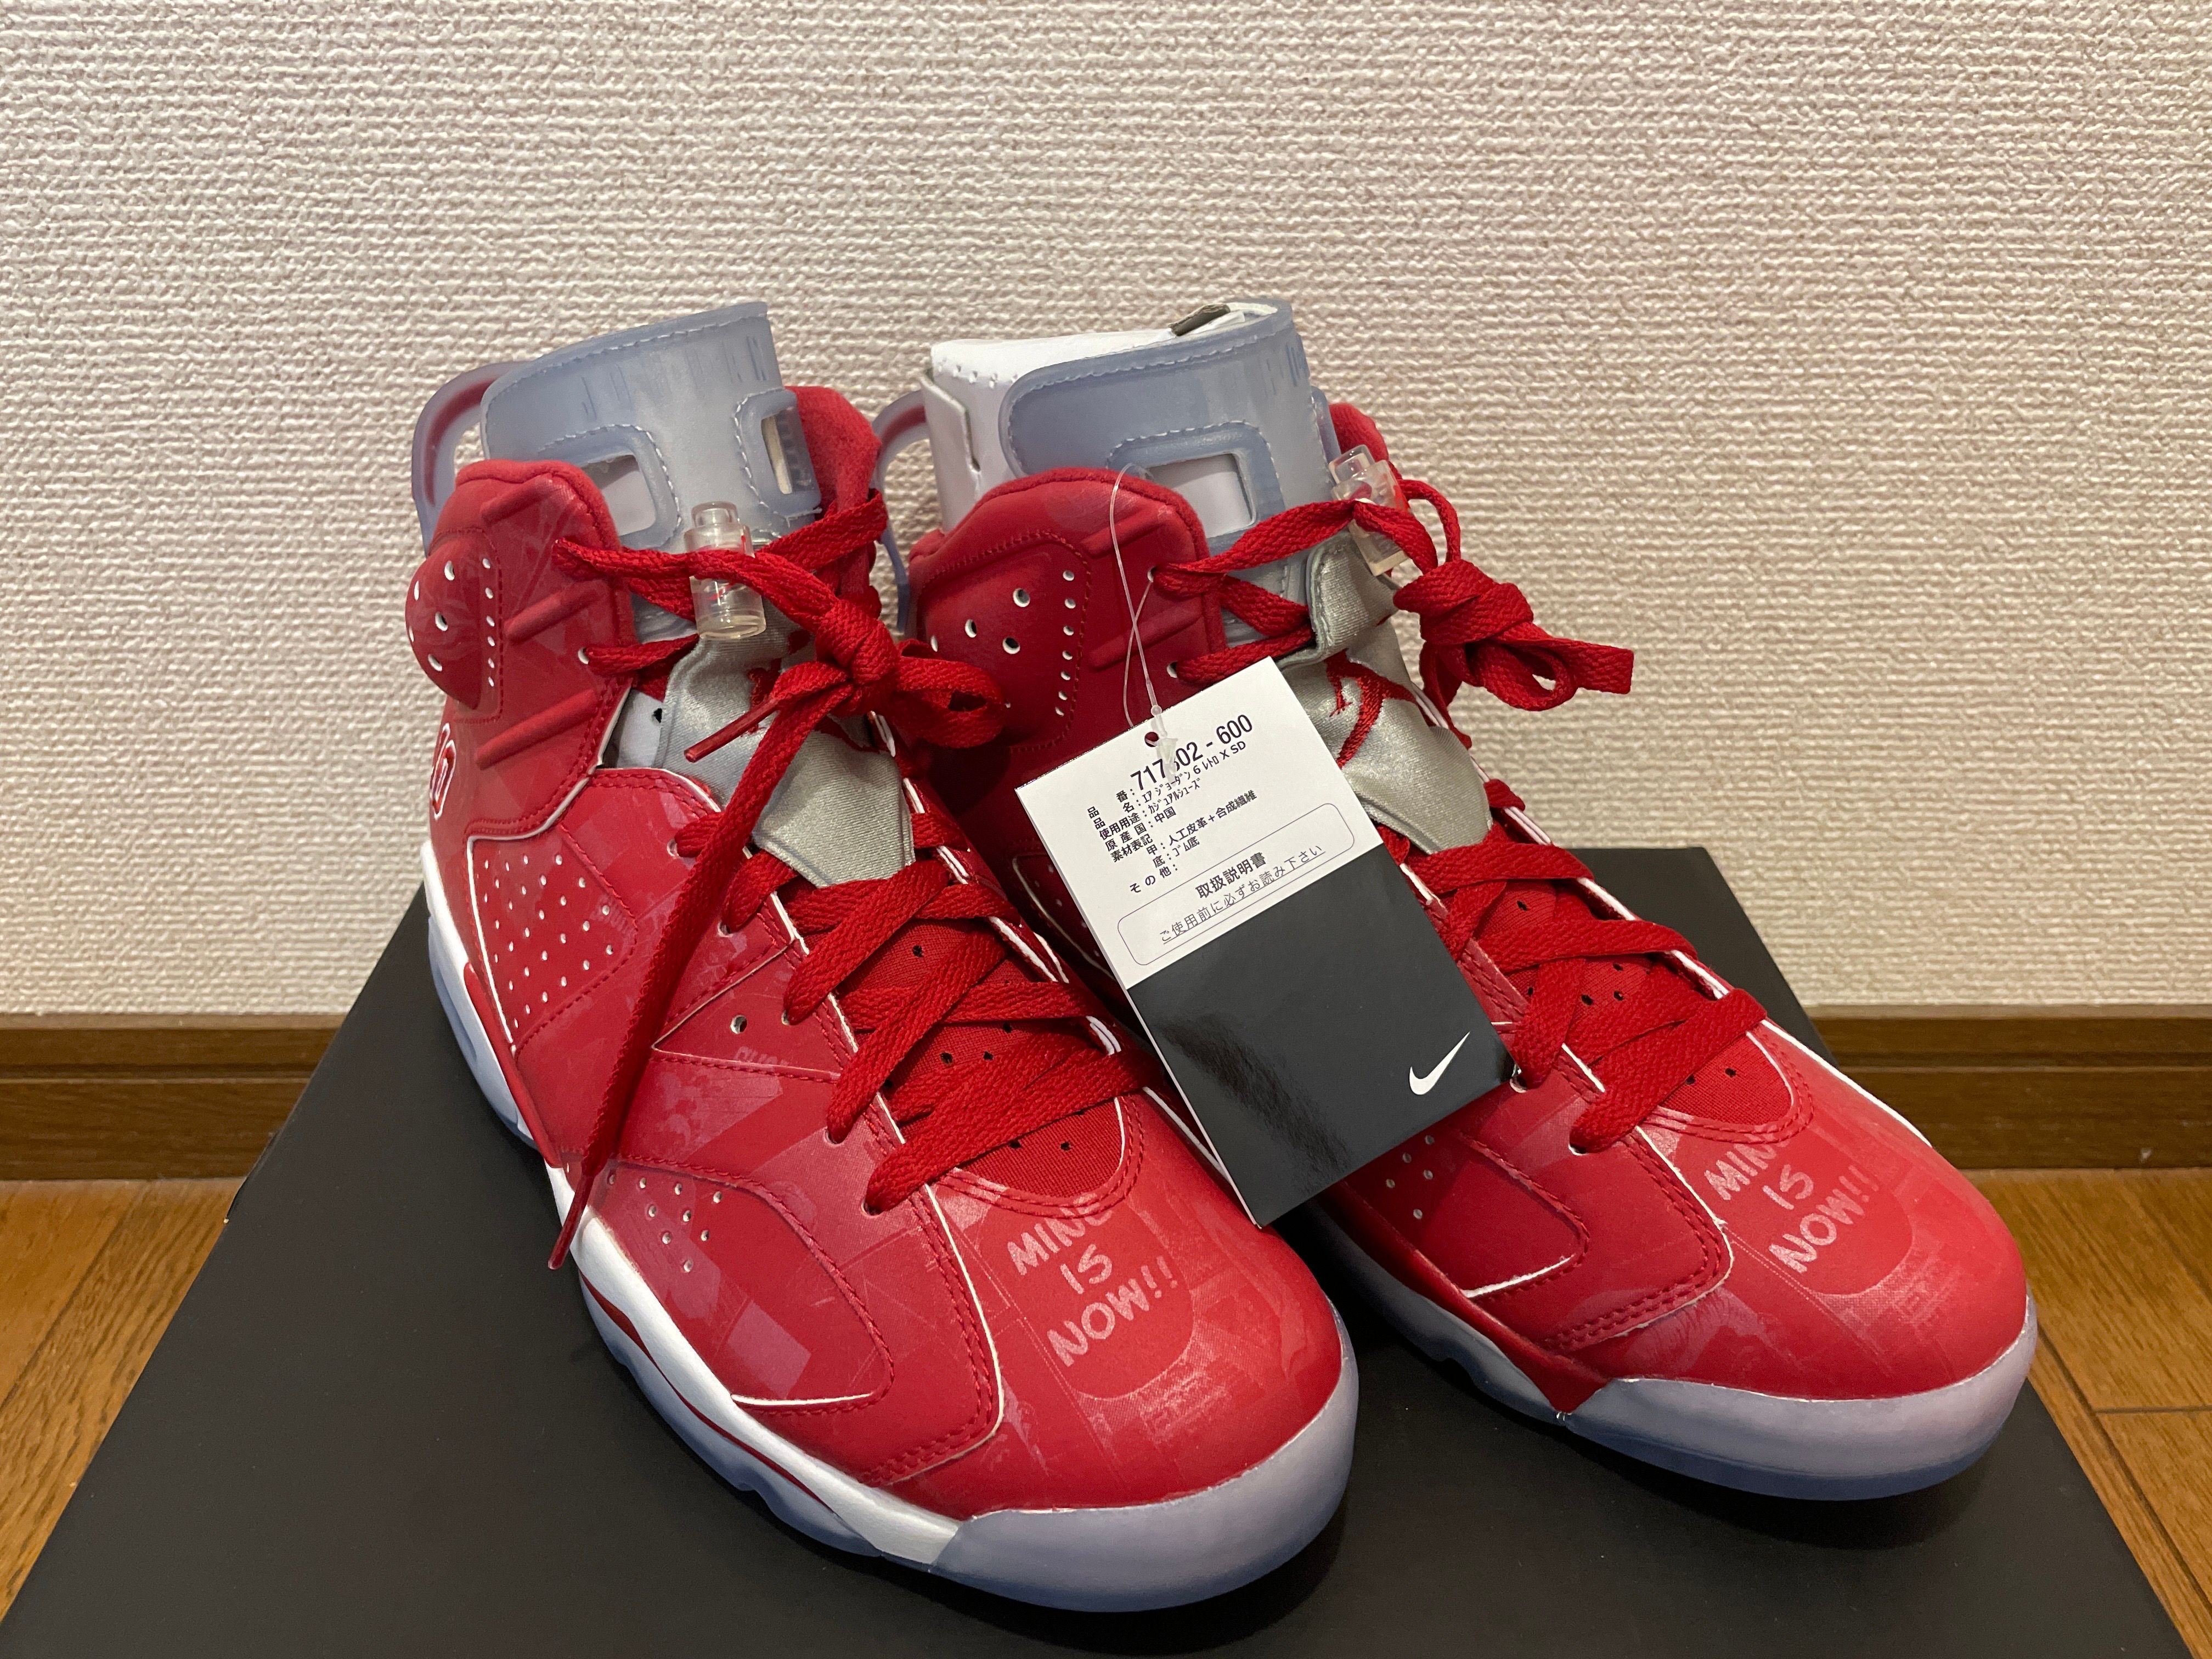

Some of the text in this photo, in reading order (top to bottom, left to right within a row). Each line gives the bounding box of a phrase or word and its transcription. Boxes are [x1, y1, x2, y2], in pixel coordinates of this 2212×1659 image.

[1216, 714, 1252, 744] 600
[1220, 749, 1230, 760] X
[1230, 741, 1246, 754] SD
[1110, 834, 1153, 862] 素材表記
[1160, 845, 1322, 942] ご使用前に必ずお読み下さい
[1195, 852, 1266, 899] 取扱説明書
[1763, 1164, 1814, 1210] IS
[1768, 1165, 1880, 1273] NOW!!
[1060, 1244, 1113, 1294] IS
[1047, 1255, 1177, 1367] NOW!!
